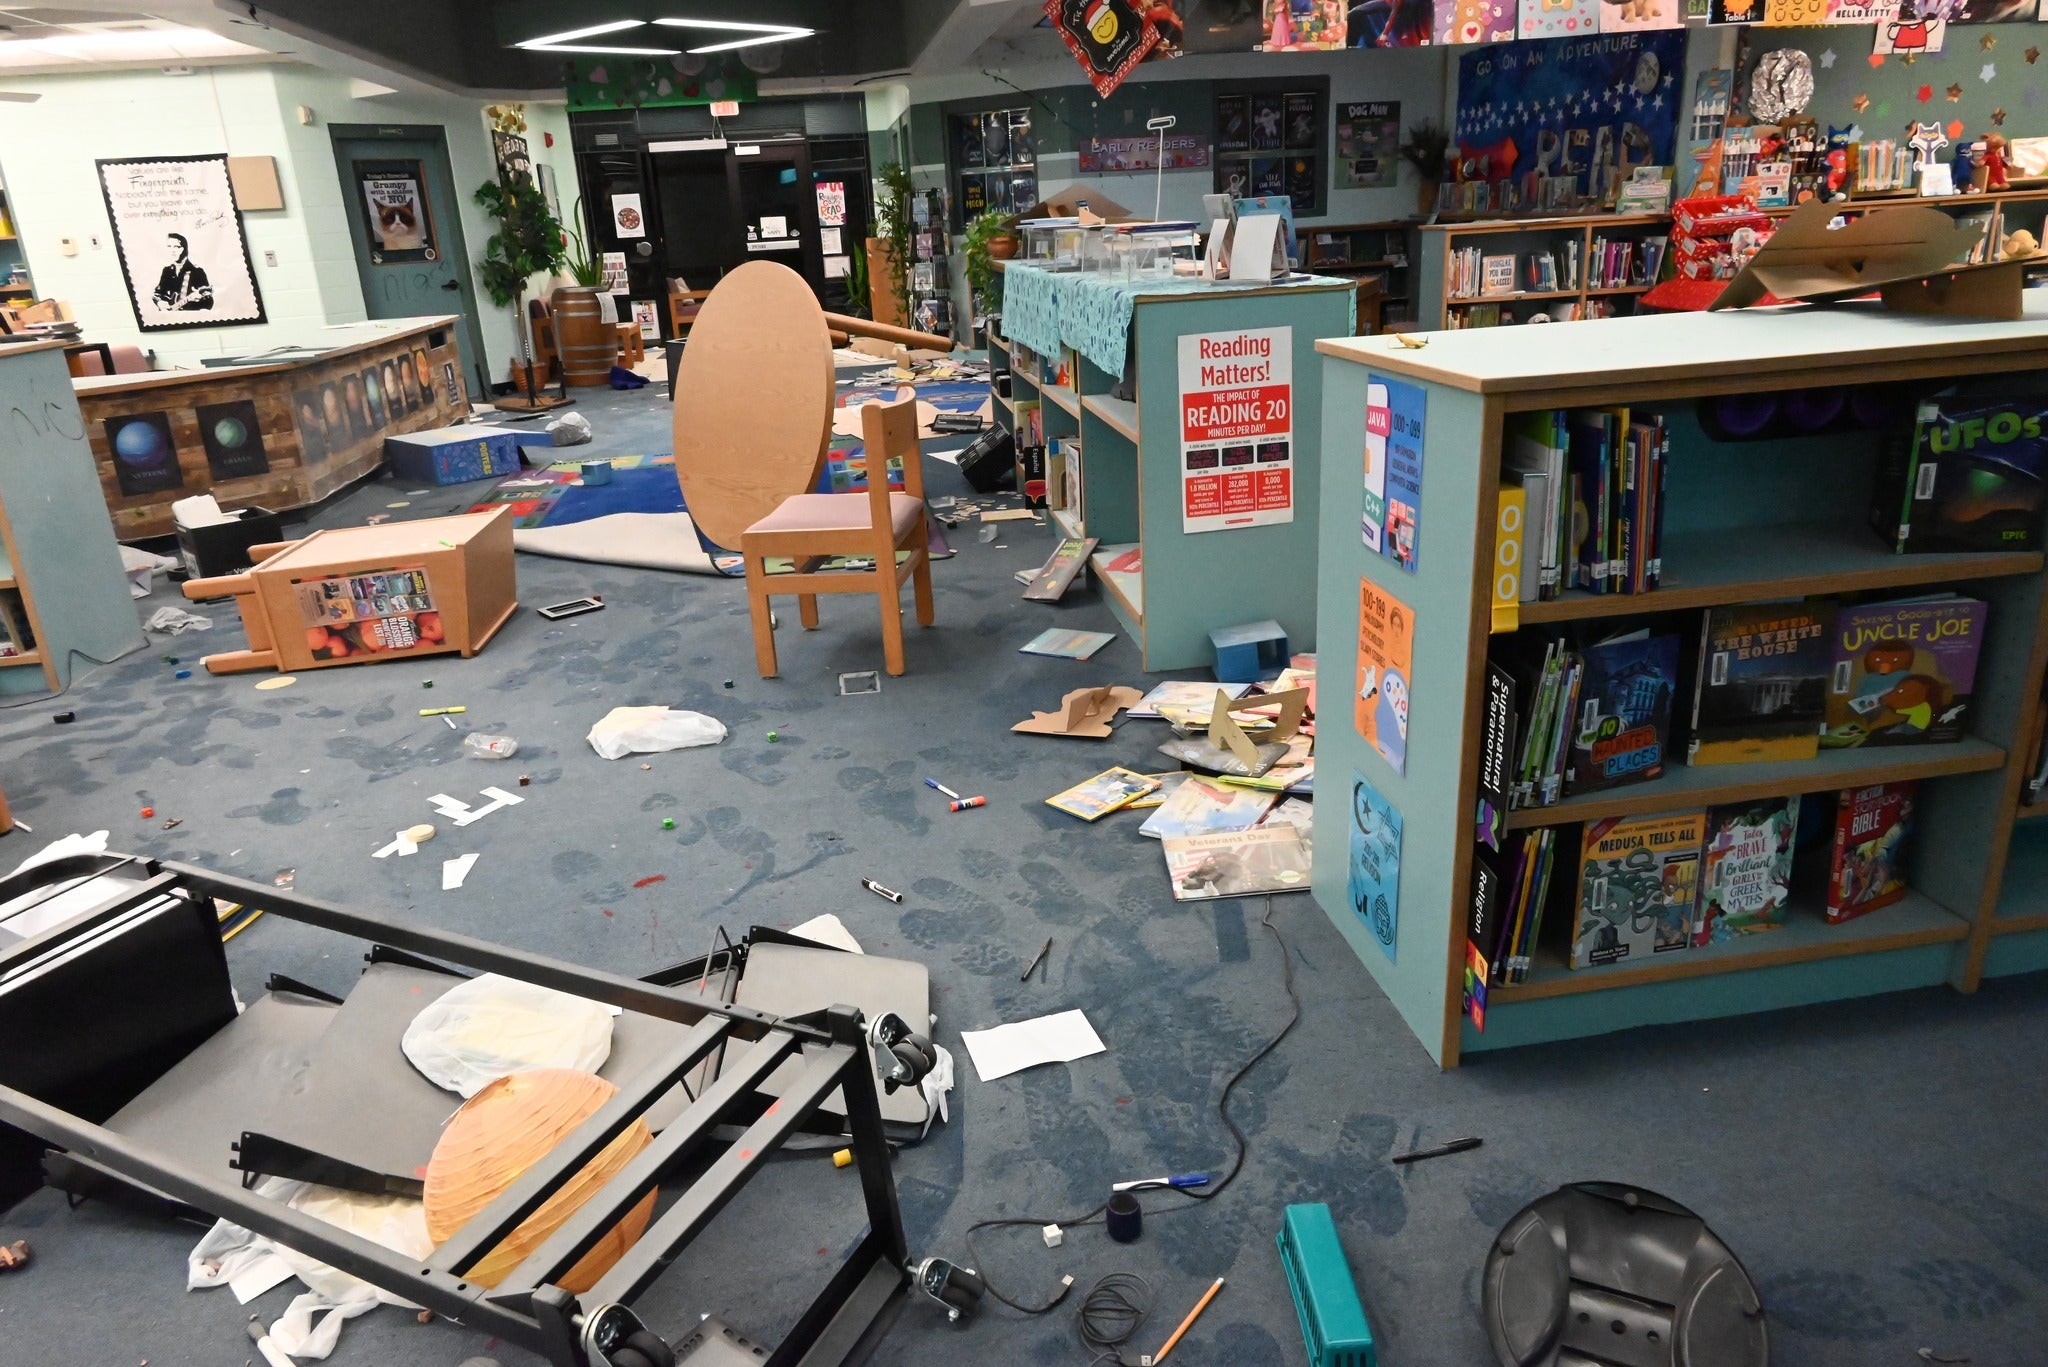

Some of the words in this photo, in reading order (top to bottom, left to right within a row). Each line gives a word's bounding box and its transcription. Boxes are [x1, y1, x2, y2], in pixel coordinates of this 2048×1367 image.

[1724, 12, 1746, 22] Table
[1836, 9, 1862, 18] HELLO
[1864, 9, 1890, 17] KITTY
[1476, 60, 1492, 76] GO
[1502, 53, 1518, 71] ON
[1526, 51, 1544, 67] AN
[1555, 34, 1639, 62] ADVENTURE
[1348, 104, 1368, 119] DOG
[1370, 103, 1389, 116] MAN
[1091, 142, 1133, 153] EARLY
[1138, 140, 1197, 152] READERS
[129, 167, 154, 175] Values
[171, 165, 184, 173] like
[155, 189, 168, 197] are
[169, 187, 182, 197] the
[372, 181, 408, 190] Grumpy
[128, 201, 143, 209] but
[144, 201, 159, 210] you
[160, 199, 183, 208] leave
[387, 194, 407, 204] NO!
[142, 209, 178, 221] everything
[179, 209, 195, 218] you
[820, 205, 842, 217] READ
[1488, 269, 1500, 278] YOU
[1500, 268, 1512, 277] NEED
[1200, 335, 1271, 359] Reading
[1201, 360, 1271, 387] Matters!
[1213, 393, 1226, 403] THE
[1226, 391, 1250, 402] IMPACT
[1251, 389, 1261, 400] OF
[1187, 402, 1261, 428] READING
[1265, 399, 1287, 420] 20
[1367, 412, 1387, 429] JAVA
[1207, 427, 1236, 438] MINUTES
[1236, 425, 1250, 435] PER
[1250, 423, 1267, 434] DAY!
[1930, 411, 2042, 454] UFOs
[479, 441, 492, 475] POSTERS
[131, 469, 168, 479] NEPTUNE
[1365, 493, 1382, 517] C++
[2001, 530, 2027, 540] EPIC
[373, 623, 384, 638] LIST
[380, 618, 395, 649] NONFICTION
[387, 617, 405, 648] BLOSSOM
[397, 616, 415, 647] ORANGE
[1713, 634, 1753, 652] THE
[1758, 624, 1823, 644] WHITE
[1843, 623, 1921, 651] UNCLE
[1926, 618, 1972, 642] JOE
[1737, 640, 1798, 661] HOUSE
[1492, 674, 1500, 688] &
[1483, 691, 1500, 789] Paranormal
[1492, 682, 1509, 794] Supernatural
[1593, 729, 1655, 758] HAUNTED
[1608, 746, 1658, 773] PLACES
[1851, 808, 1882, 837] BIBLE
[1188, 836, 1244, 848] Veterans
[1246, 833, 1272, 844] Day
[1598, 835, 1645, 853] MEDUSA
[1648, 830, 1675, 846] TELLS
[1678, 828, 1696, 842] ALL
[1743, 829, 1763, 841] Tales
[1736, 837, 1767, 860] BRAVE
[1361, 852, 1381, 886] RELIGION
[1725, 856, 1772, 877] Brilliant
[1732, 873, 1756, 887] GIRLS
[1730, 882, 1763, 898] GREEK
[1474, 870, 1488, 934] Religion
[1727, 893, 1763, 909] MYTHS
